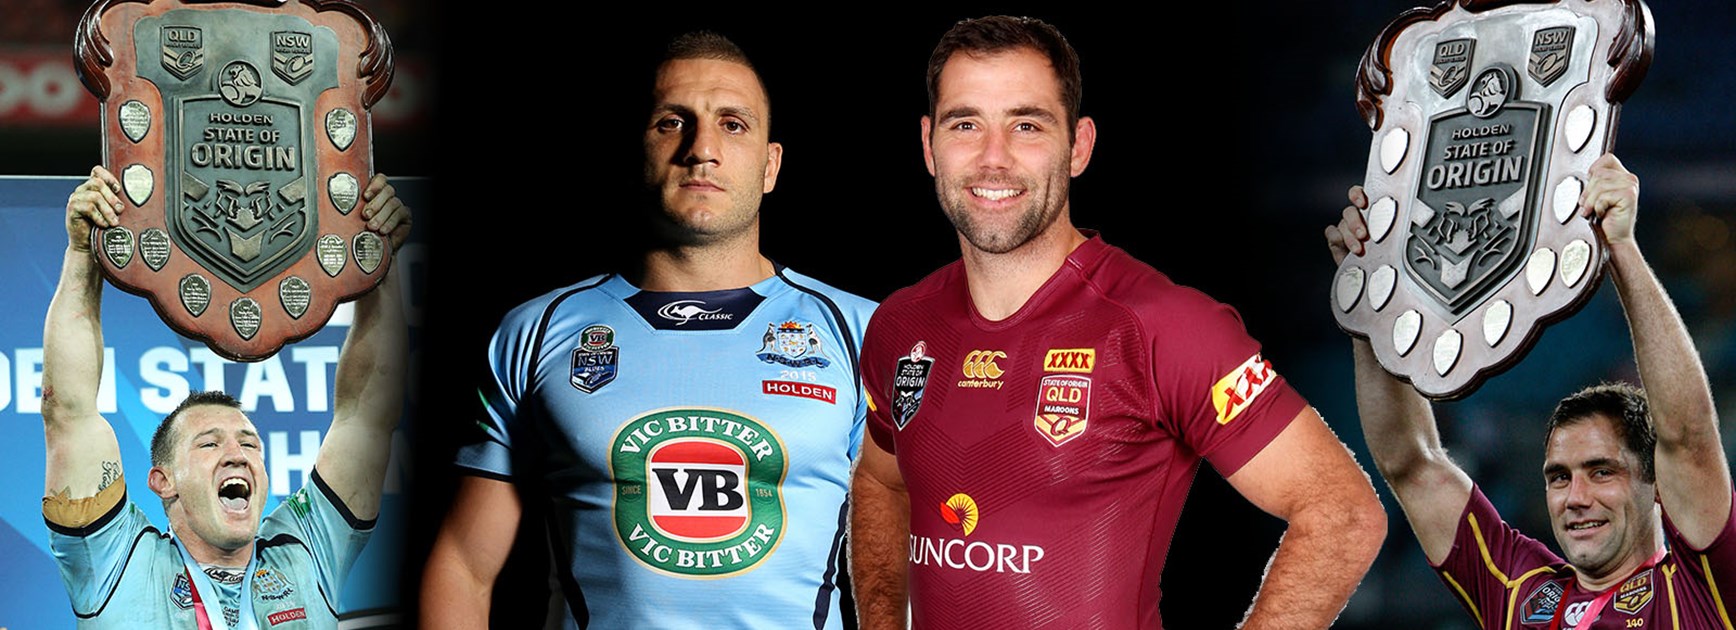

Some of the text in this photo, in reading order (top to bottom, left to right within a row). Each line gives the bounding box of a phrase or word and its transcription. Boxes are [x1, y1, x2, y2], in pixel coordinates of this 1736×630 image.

[168, 30, 197, 43] QLD
[276, 35, 310, 48] NSW
[1535, 31, 1568, 46] NSW
[1439, 43, 1465, 57] QLD
[210, 112, 274, 125] HOLDEN
[204, 126, 280, 143] STATE OF
[1452, 124, 1510, 139] HOLDEN
[191, 142, 296, 170] ORIGIN
[1444, 139, 1513, 160] STATE OF
[1426, 155, 1522, 189] ORIGIN
[698, 313, 734, 321] CLASSIC
[578, 353, 613, 367] NSW
[1047, 351, 1091, 369] XXXX
[780, 370, 817, 381] 2015
[896, 376, 925, 387] ORIGIN
[767, 383, 832, 400] HOLDEN
[957, 379, 1004, 390] canterbury
[1046, 387, 1082, 403] QLD
[1044, 405, 1080, 415] MAROONS
[620, 416, 774, 461] VIC BITTER
[622, 485, 642, 496] SINCE
[651, 468, 744, 511] VB
[755, 488, 773, 498] 1854
[628, 523, 775, 569] VIC BITTER
[1620, 576, 1647, 594] QLD
[271, 610, 305, 623] HOLDEN
[1626, 618, 1644, 629] 140
